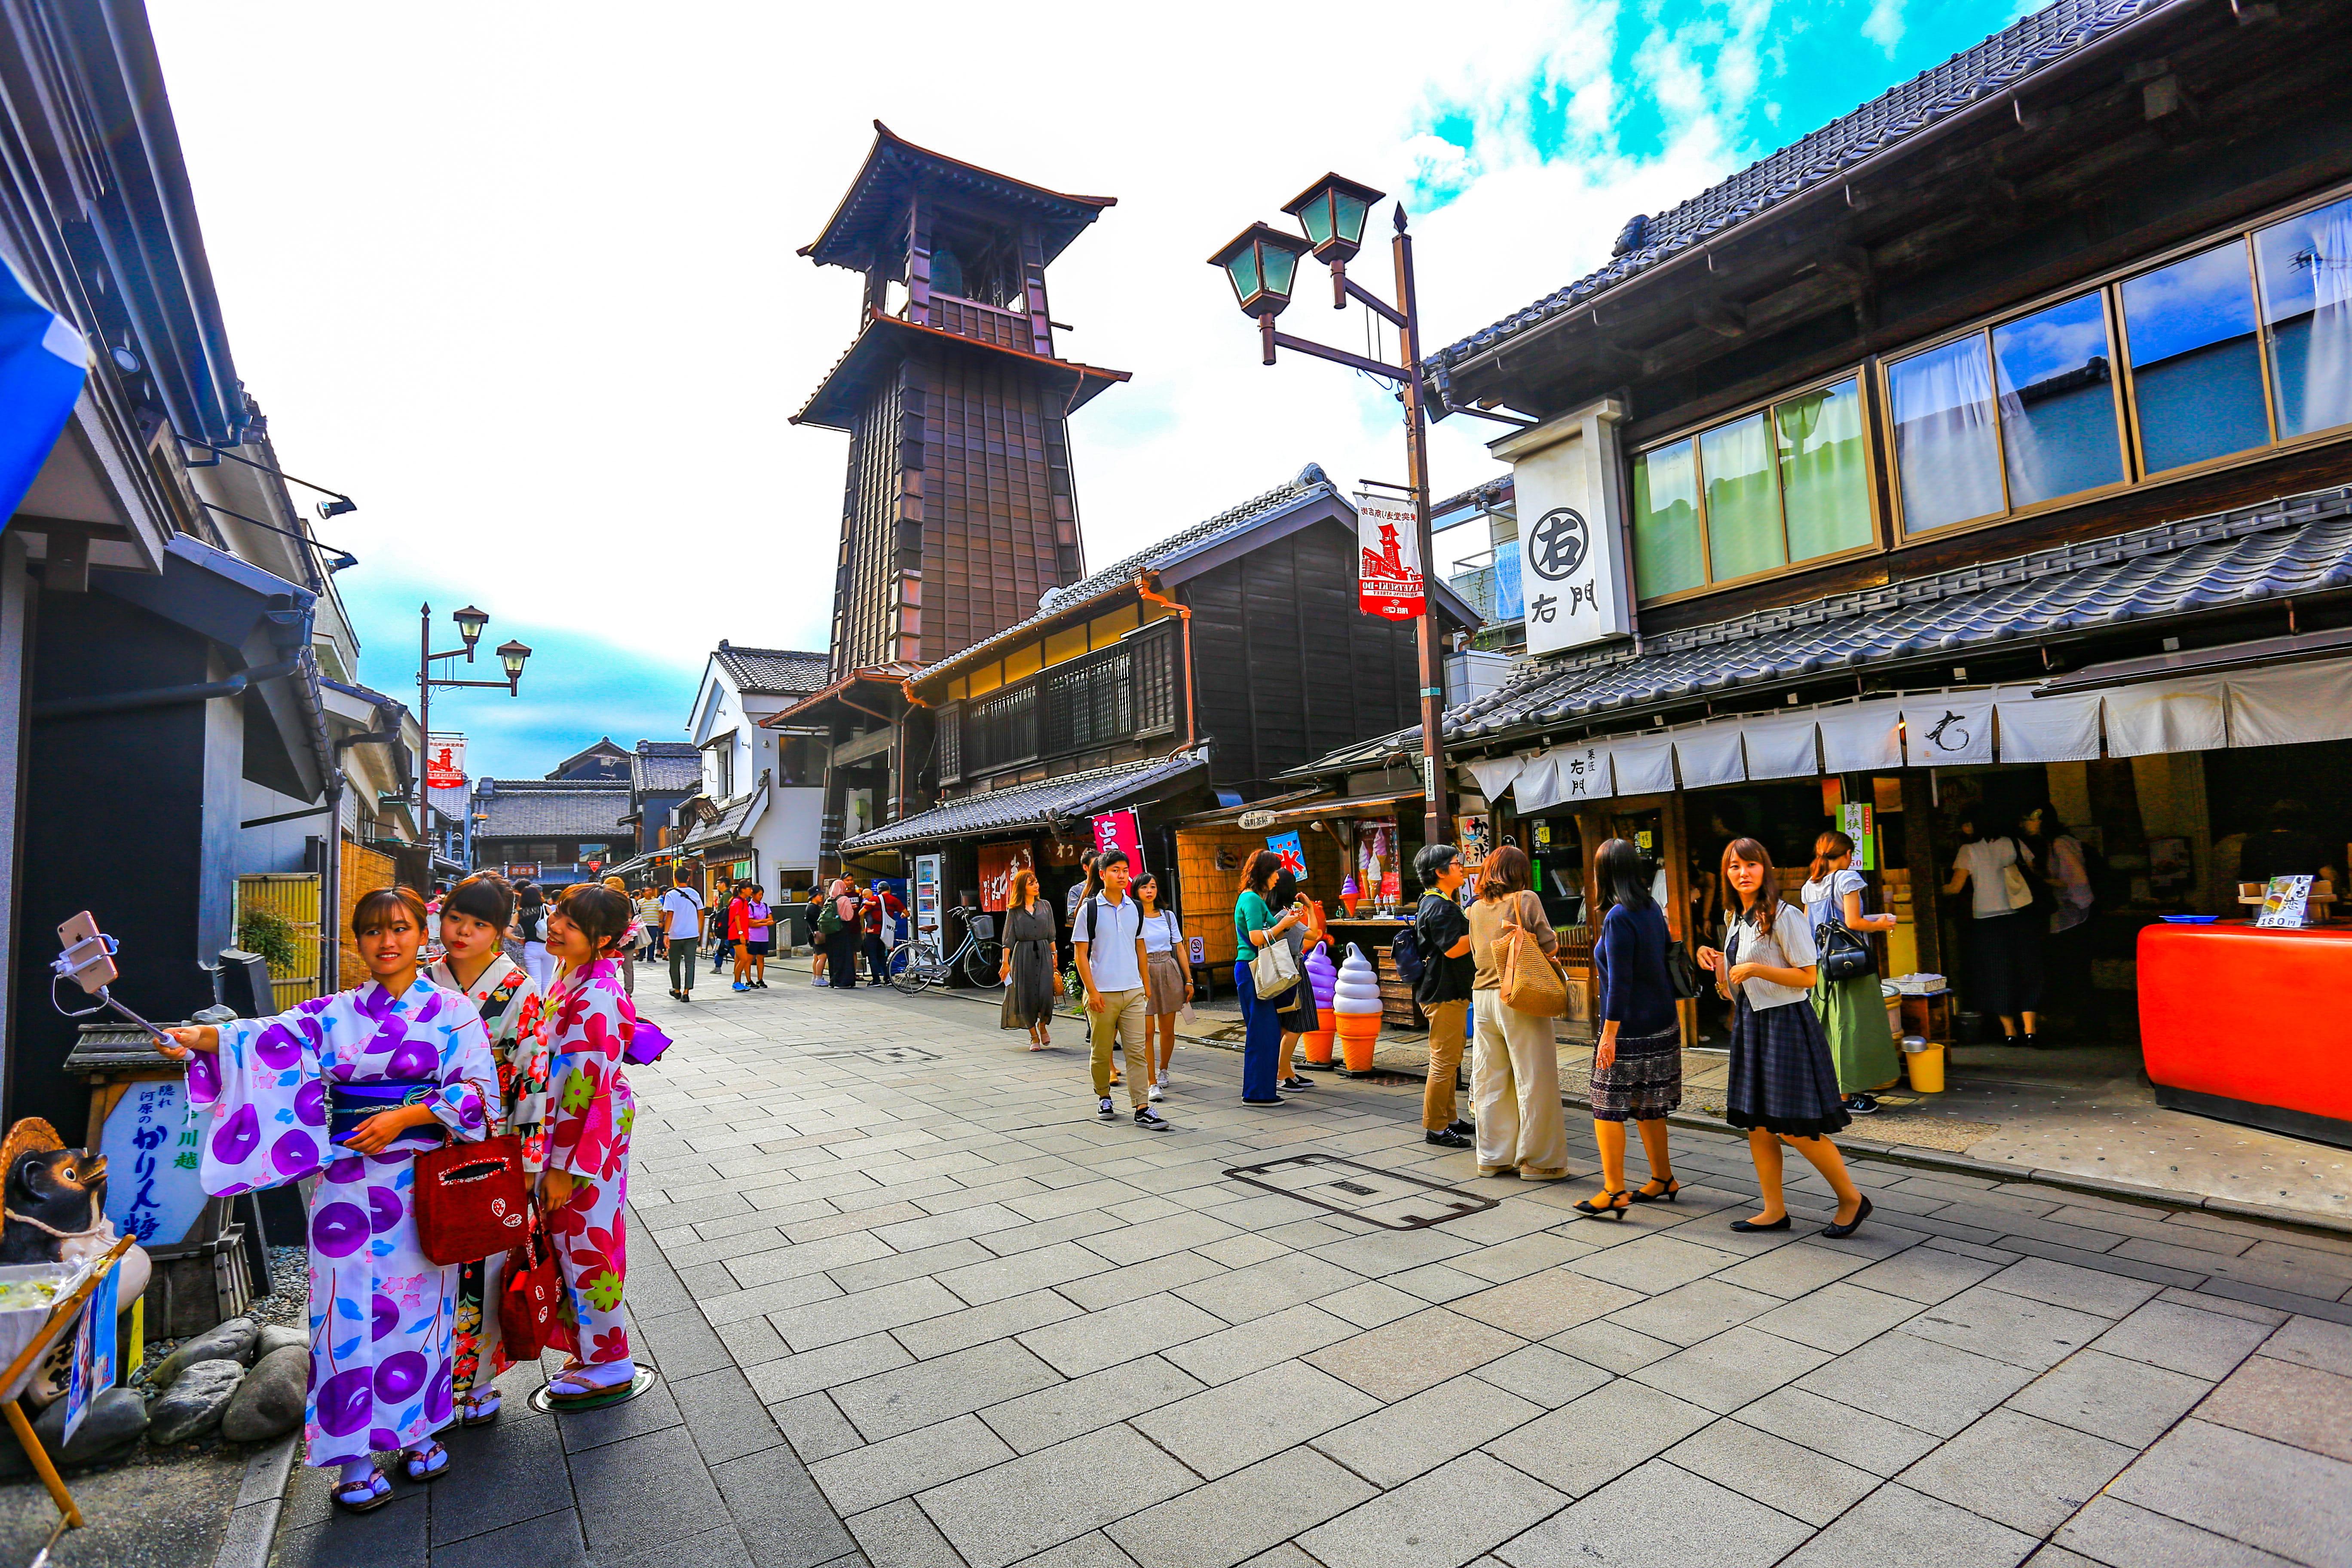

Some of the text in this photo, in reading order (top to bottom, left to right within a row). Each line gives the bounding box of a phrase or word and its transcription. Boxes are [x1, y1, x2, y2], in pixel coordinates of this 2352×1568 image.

[1537, 517, 1581, 573] 右
[1532, 579, 1598, 623] 右門
[1571, 759, 1586, 795] 右門
[1587, 748, 1595, 772] 菓匠
[1849, 805, 1859, 816] 茶
[1470, 817, 1488, 863] かき氷
[2260, 917, 2296, 926] 180円
